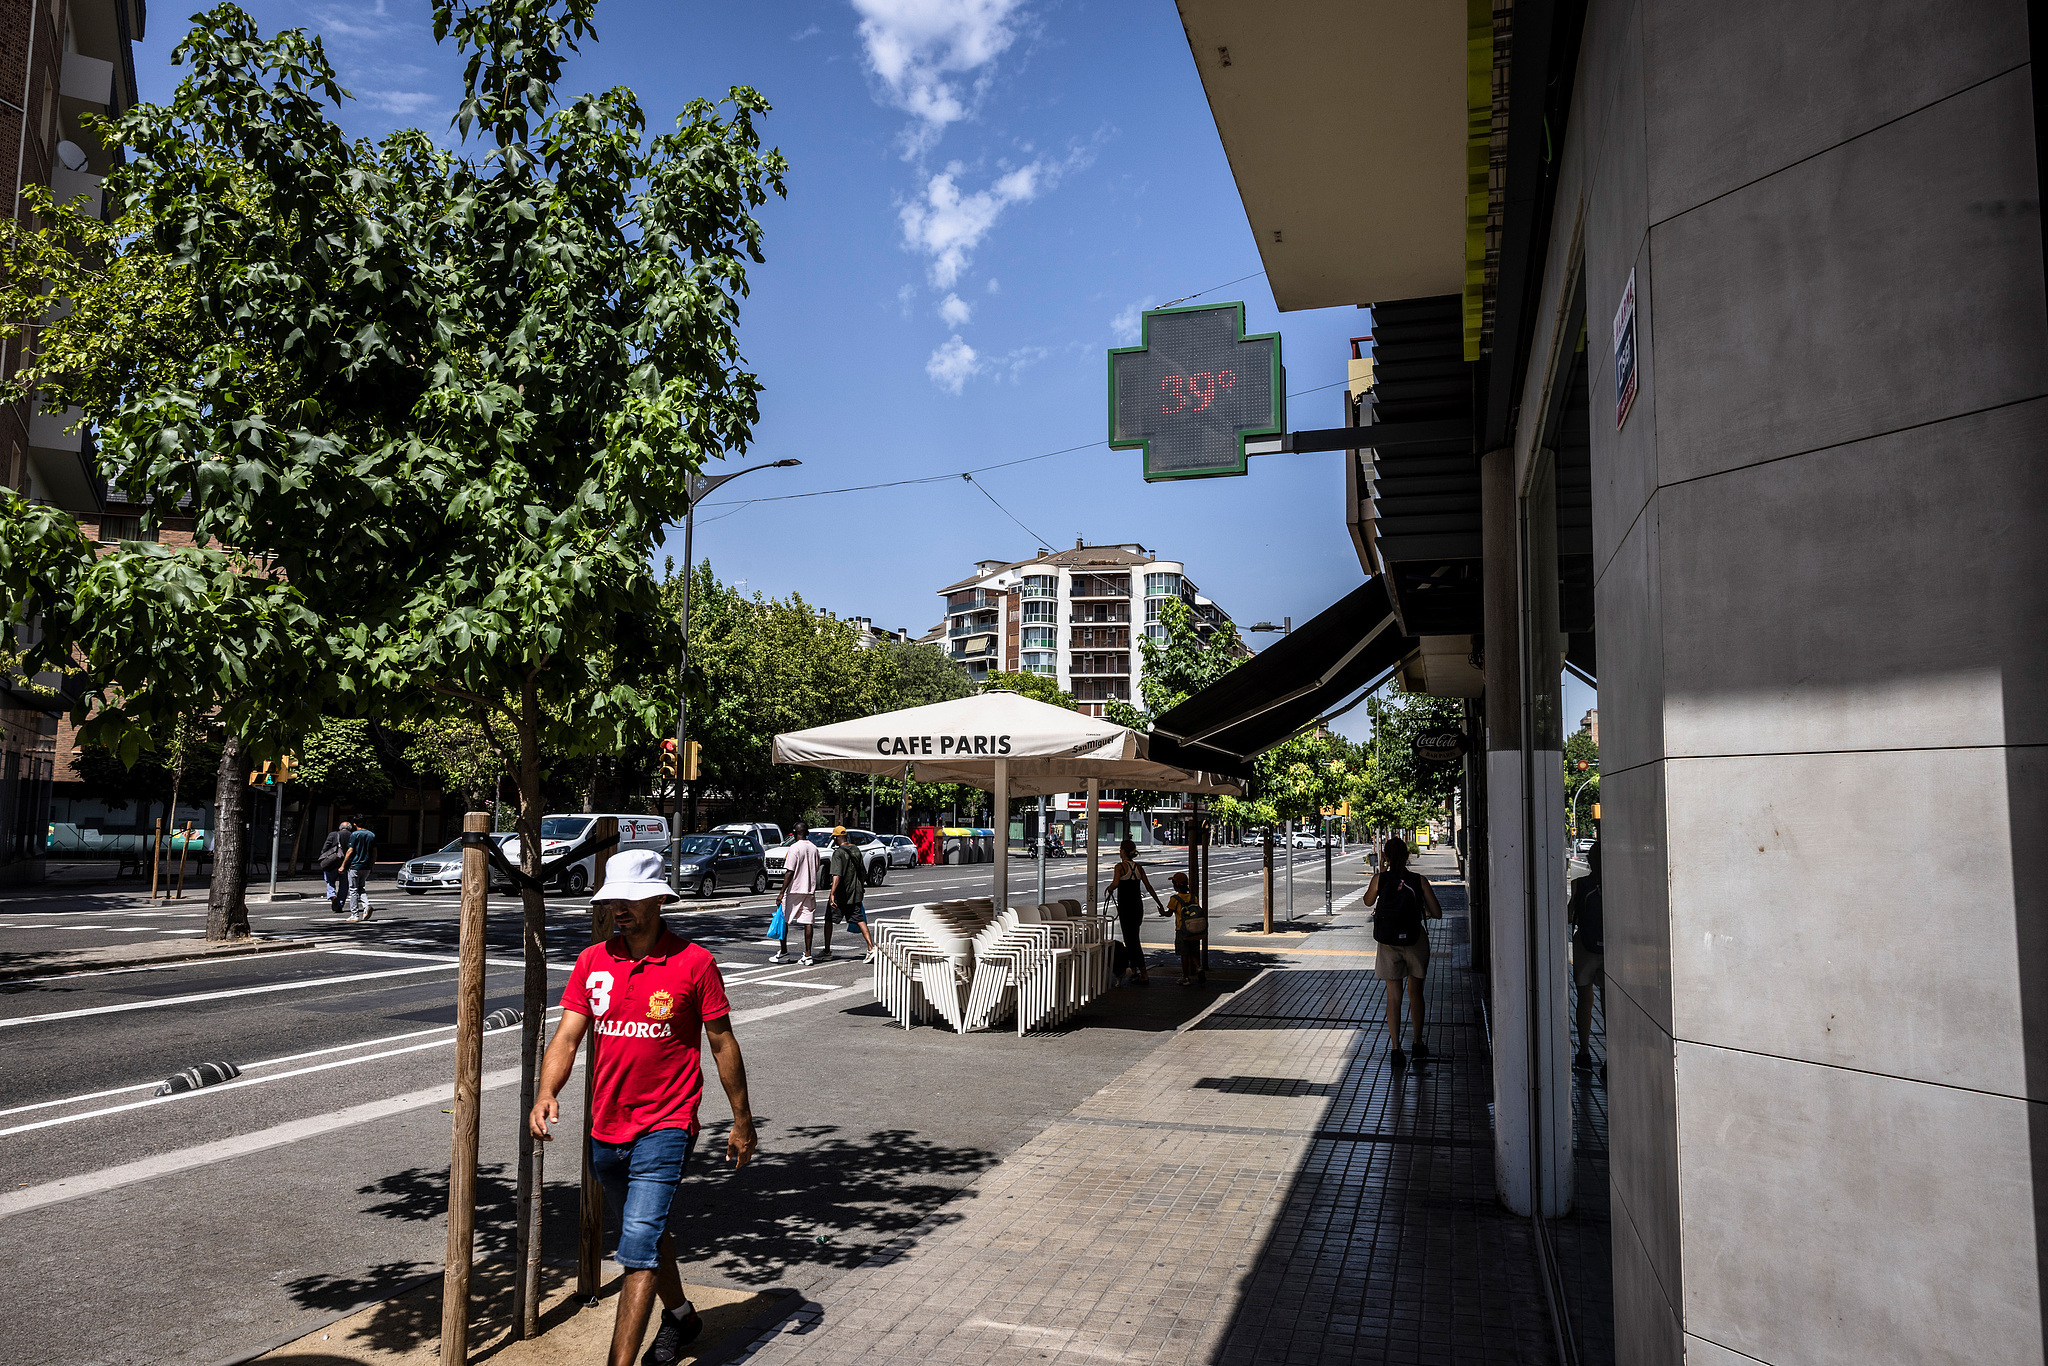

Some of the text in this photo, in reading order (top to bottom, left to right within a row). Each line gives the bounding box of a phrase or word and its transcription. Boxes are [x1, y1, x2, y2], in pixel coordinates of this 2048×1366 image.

[876, 735, 1011, 755] CAFE PARIS
[585, 970, 614, 1016] 3
